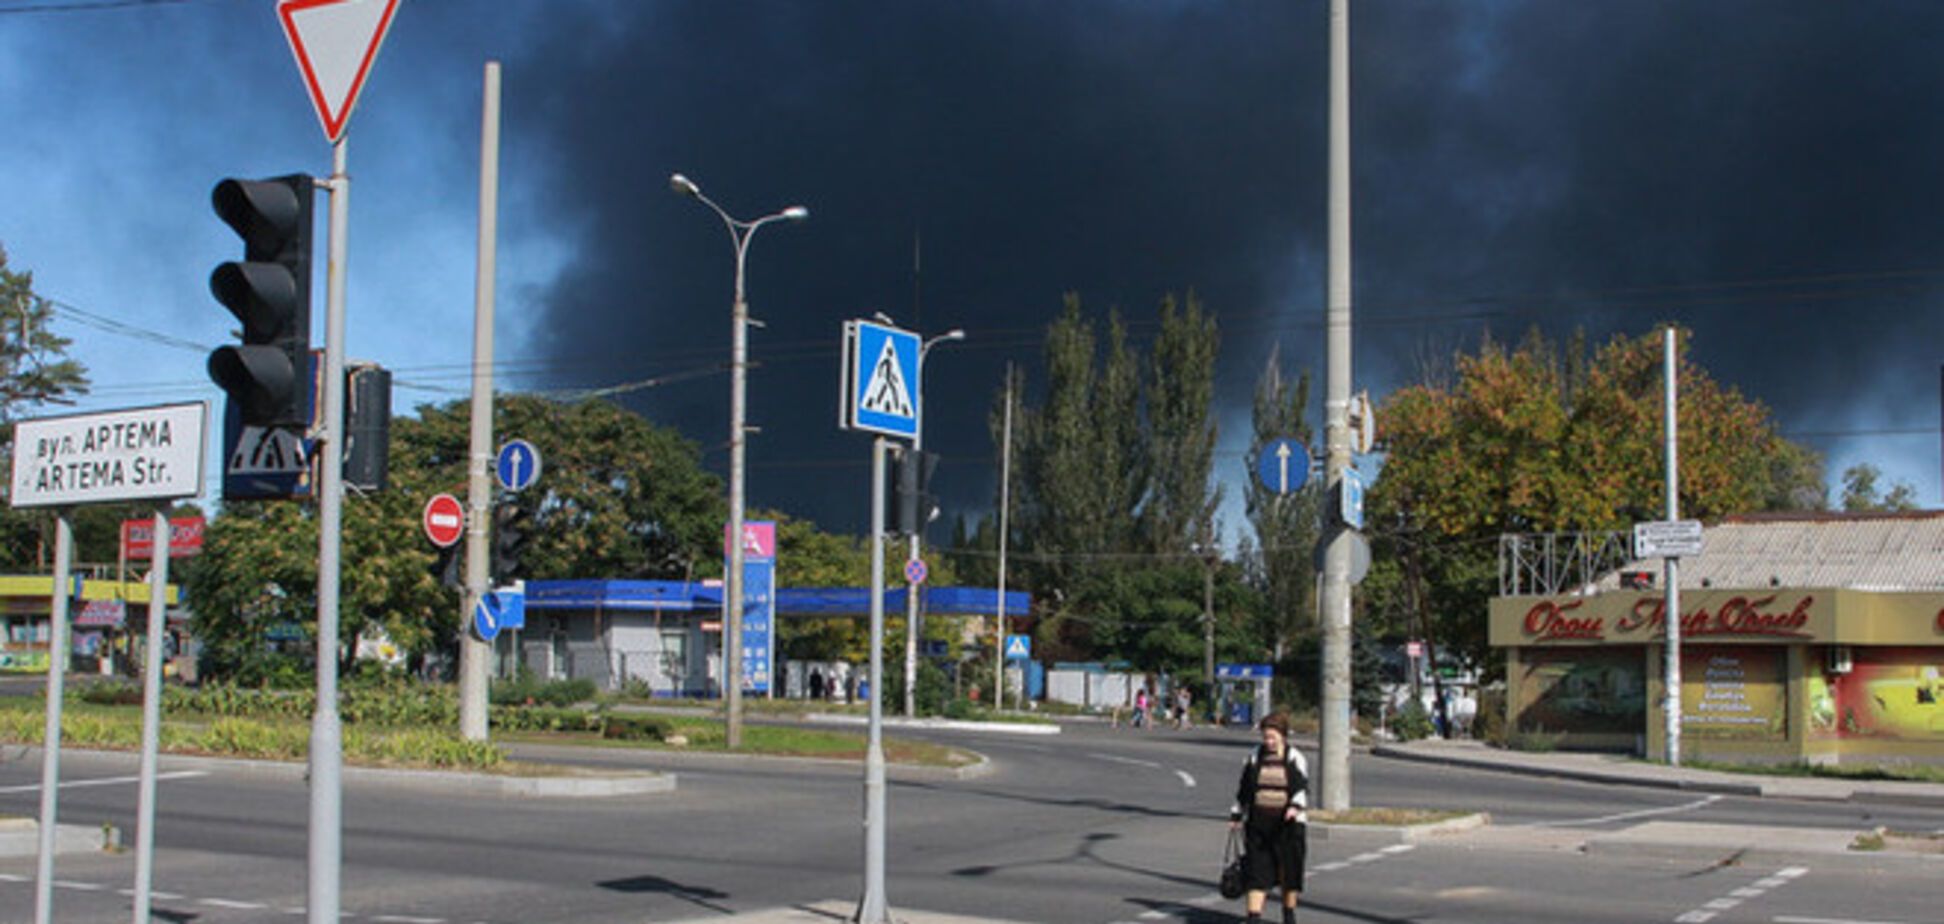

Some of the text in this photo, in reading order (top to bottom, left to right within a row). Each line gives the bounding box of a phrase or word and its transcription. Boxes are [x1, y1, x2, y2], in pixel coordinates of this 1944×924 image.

[37, 420, 172, 463] вул. АРТЕМА
[36, 456, 172, 493] ARTEMA Str.
[1524, 600, 1605, 640] Обои
[1718, 595, 1815, 634] Обоев
